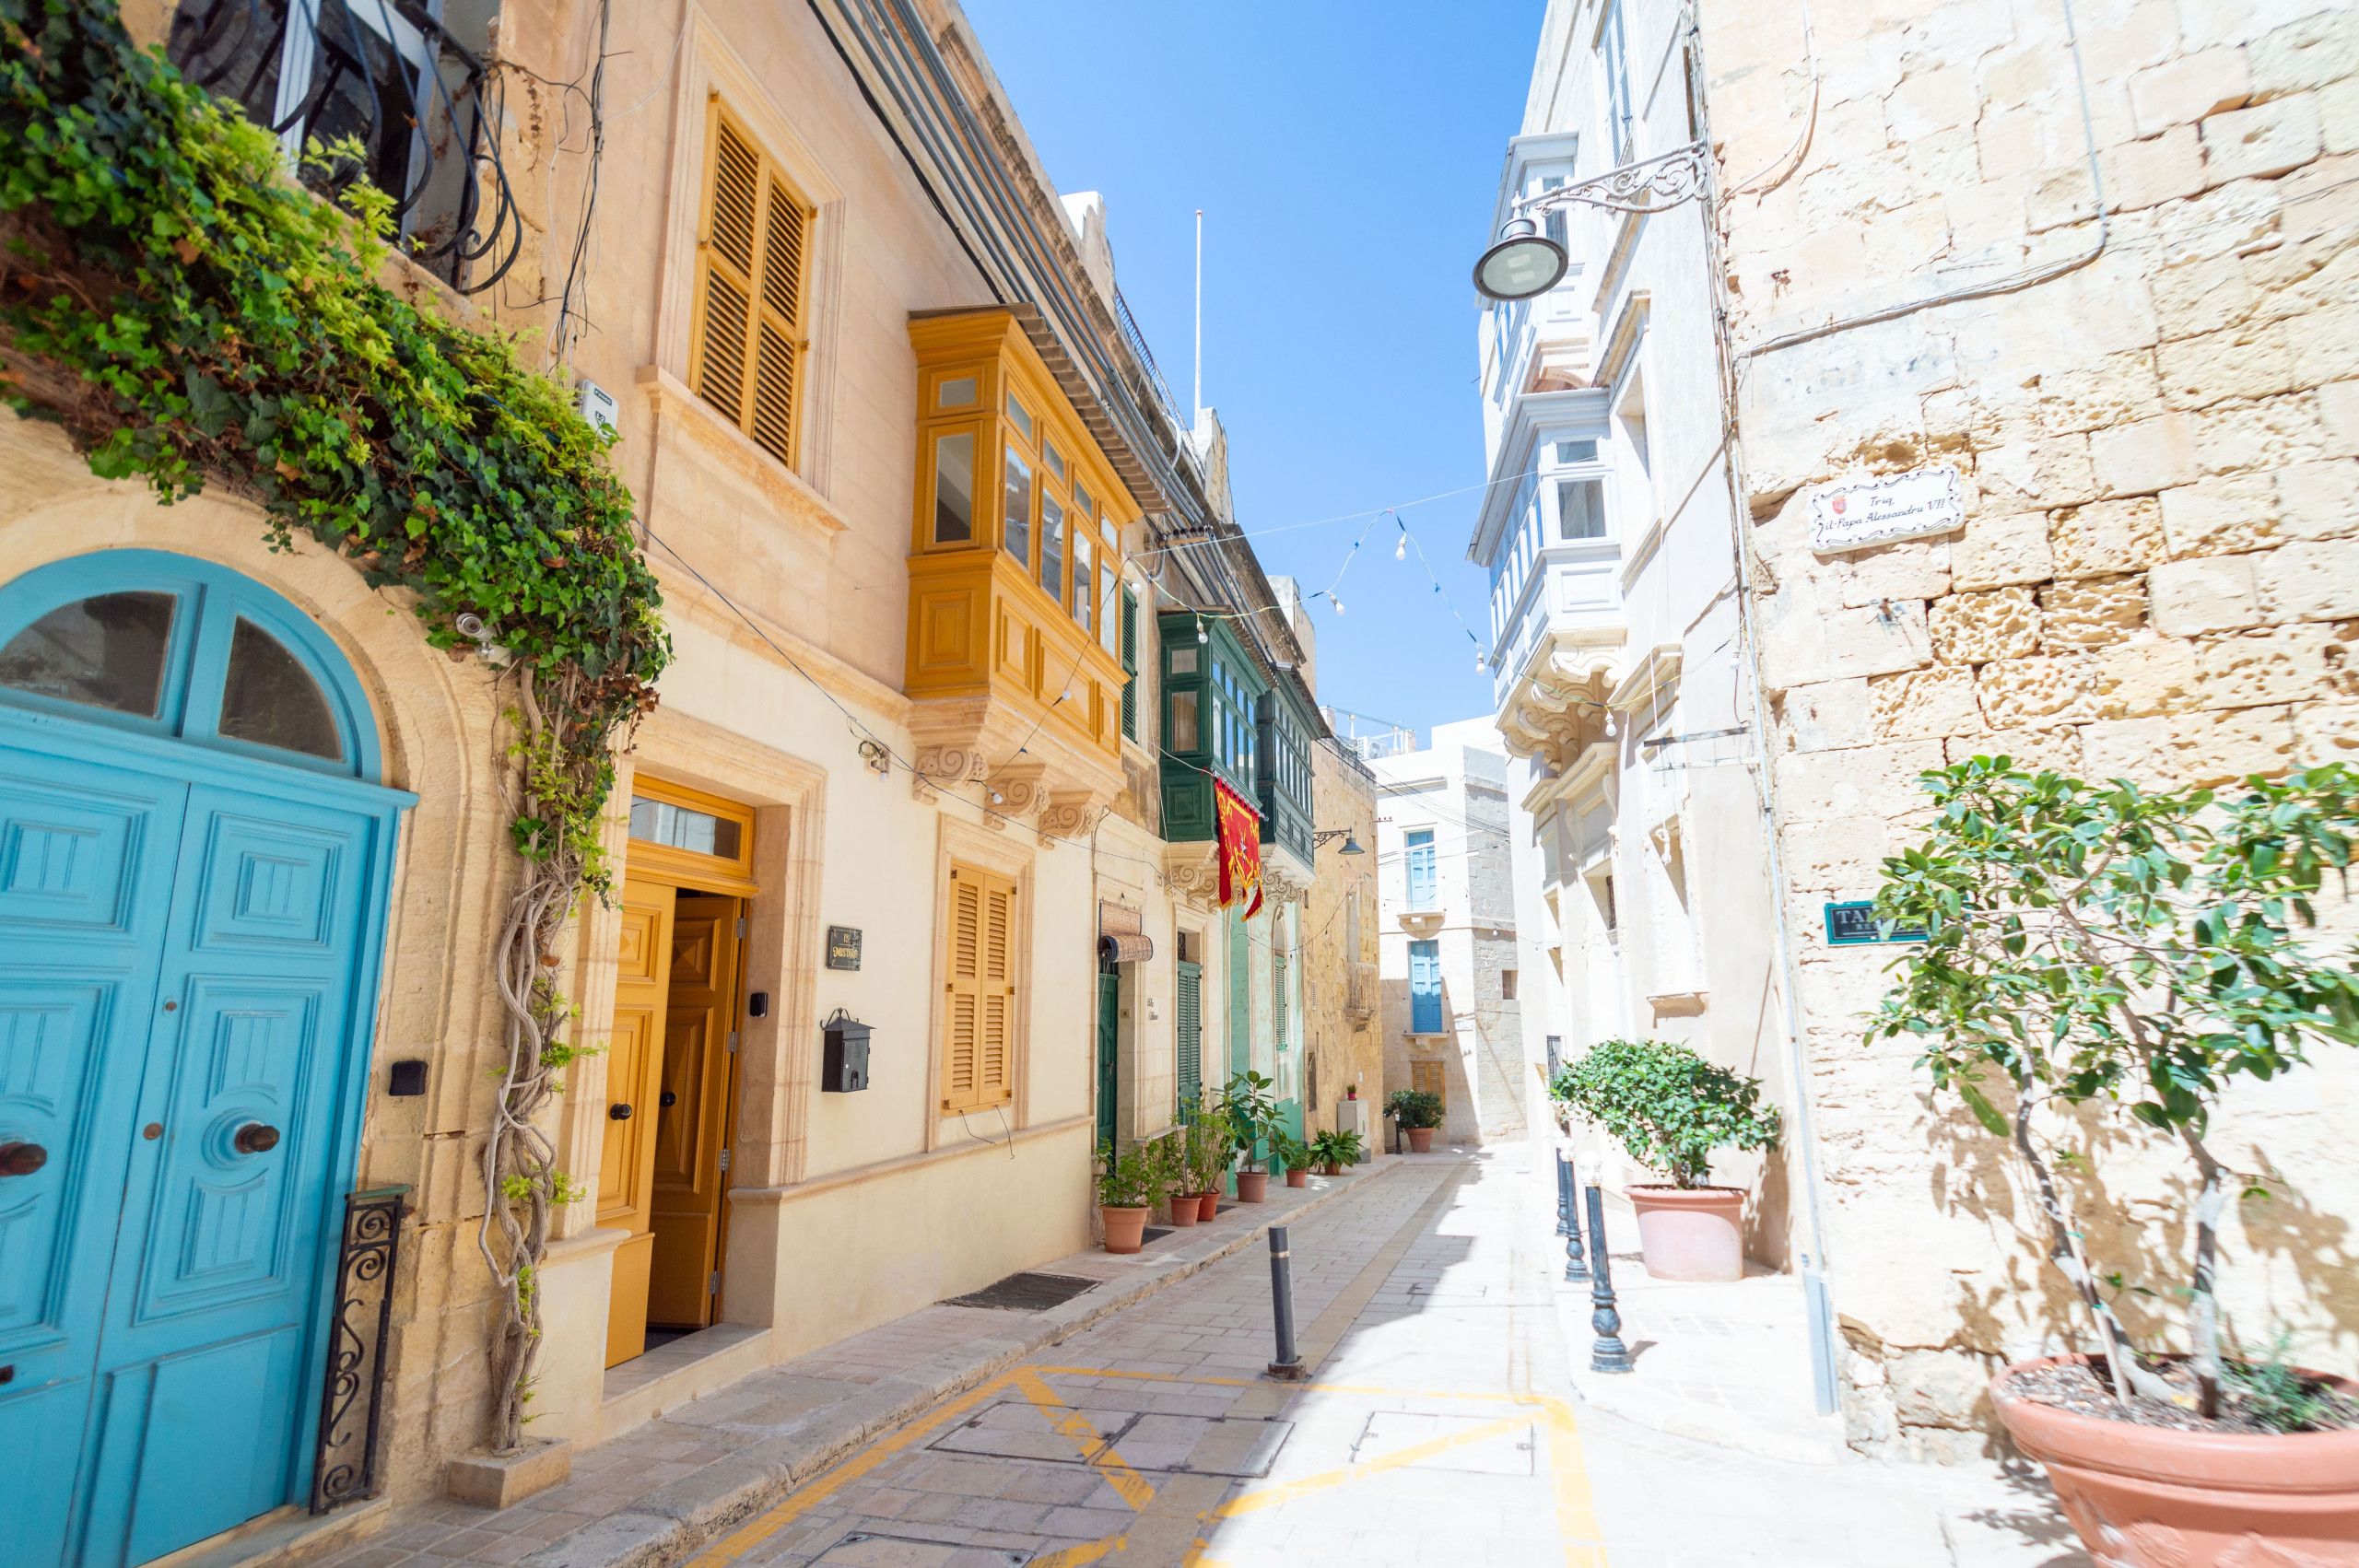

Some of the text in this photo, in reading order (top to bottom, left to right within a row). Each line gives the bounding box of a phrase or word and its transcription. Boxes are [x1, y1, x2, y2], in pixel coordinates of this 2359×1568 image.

[1871, 496, 1895, 507] Triq
[1825, 498, 1945, 530] il-Papa Alessandru VII
